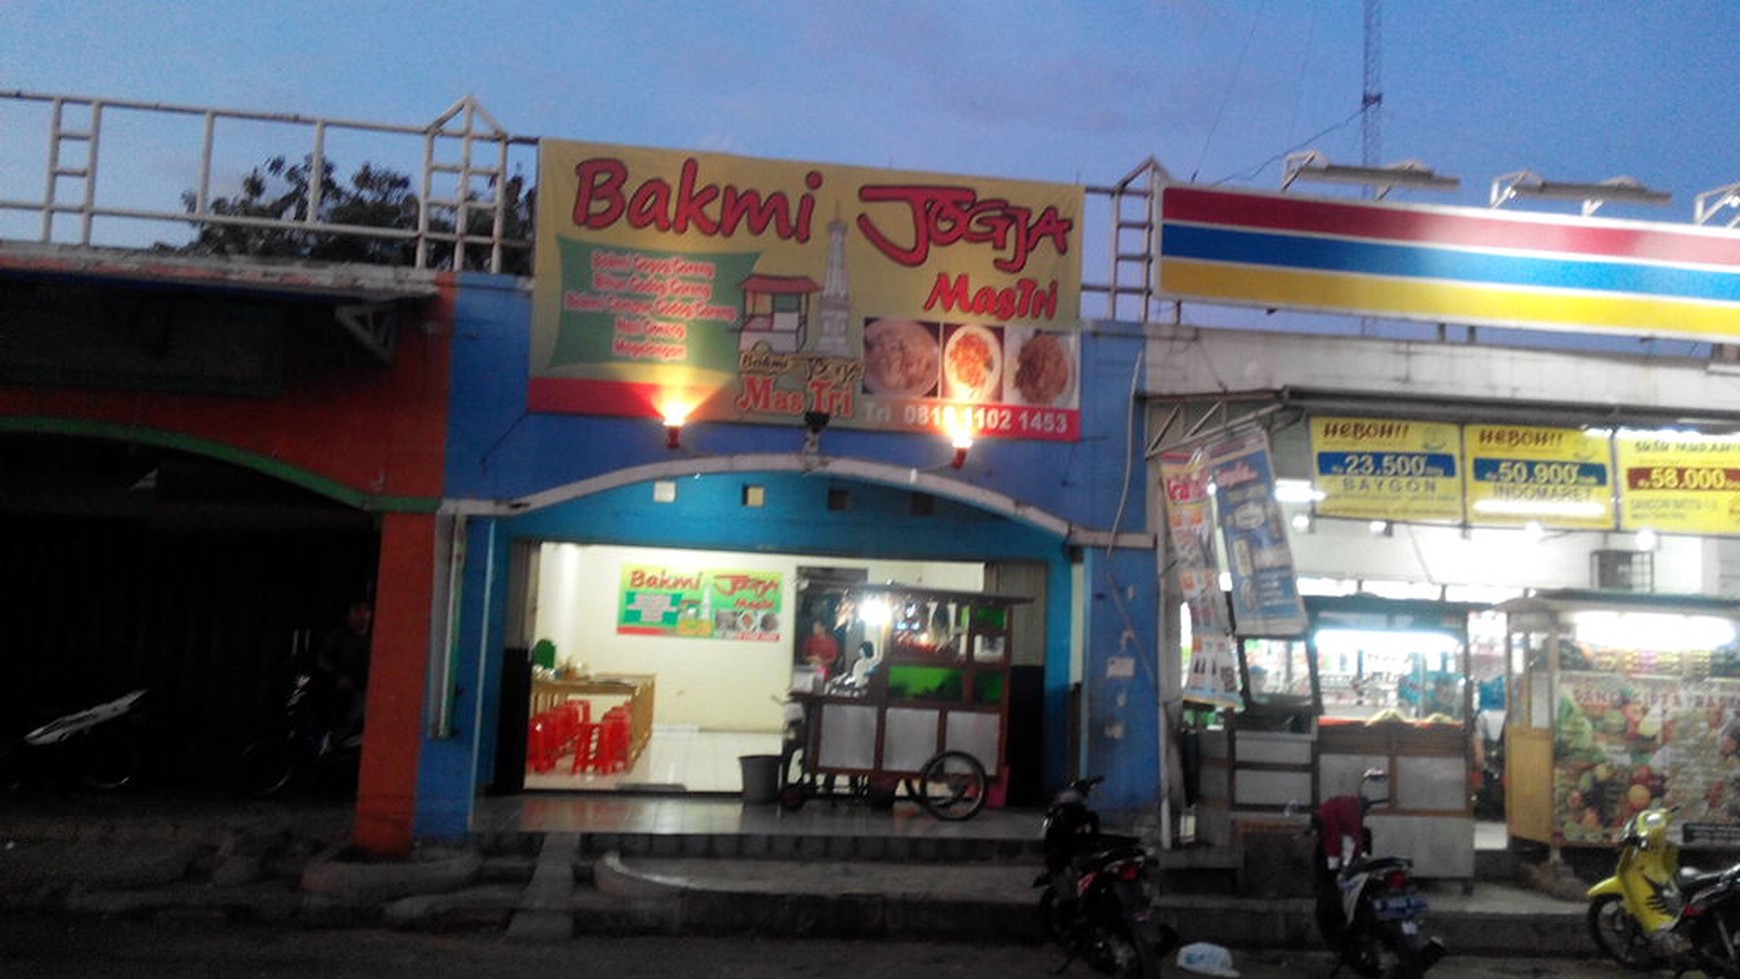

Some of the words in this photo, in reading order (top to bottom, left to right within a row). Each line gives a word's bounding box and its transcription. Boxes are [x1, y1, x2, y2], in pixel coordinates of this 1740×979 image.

[572, 157, 824, 245] Bakmi
[856, 184, 1074, 274] JOGJA
[737, 374, 805, 414] Mas
[808, 379, 855, 417] Tri
[1018, 410, 1068, 434] 1453
[1343, 477, 1437, 492] BAYGON
[630, 569, 703, 590] Bakmi
